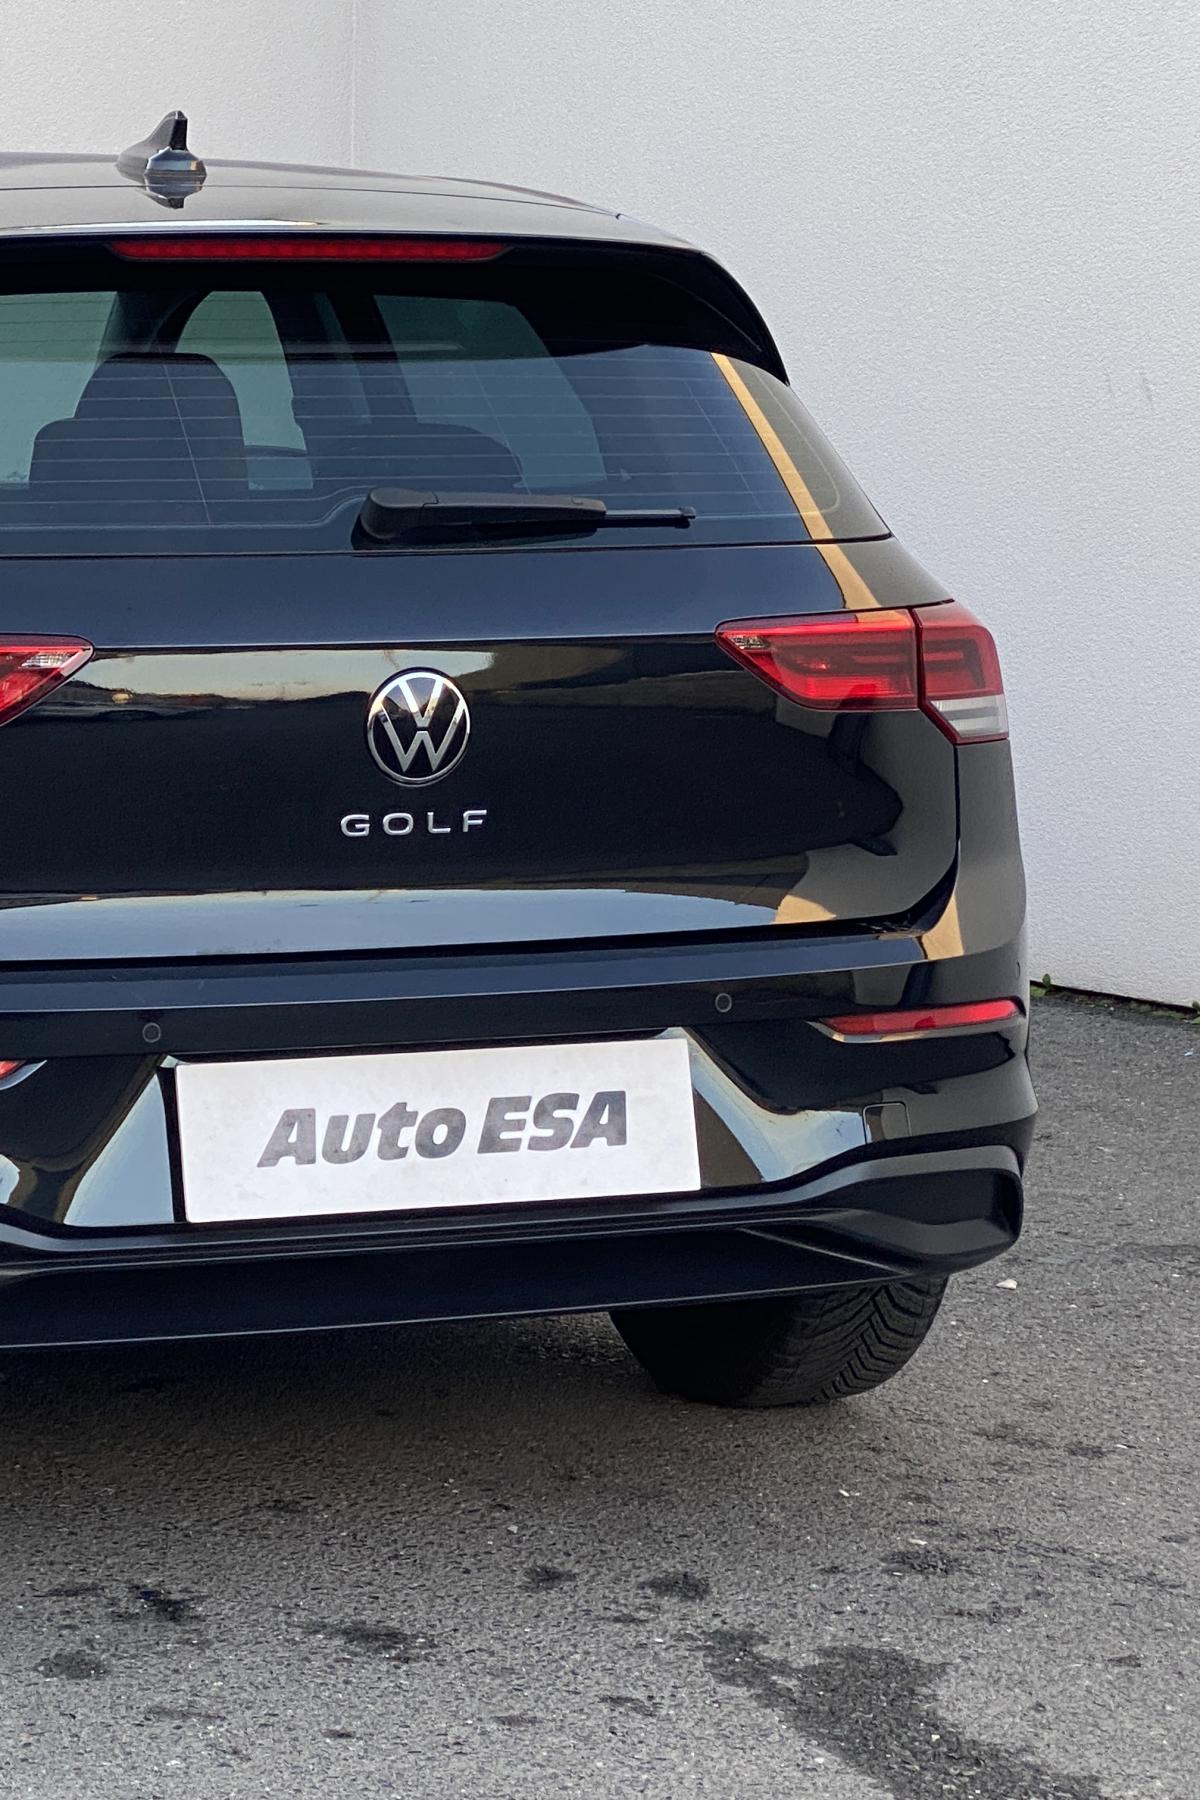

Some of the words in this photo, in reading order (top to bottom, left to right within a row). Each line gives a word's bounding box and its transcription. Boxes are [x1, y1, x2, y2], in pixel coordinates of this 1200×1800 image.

[373, 674, 468, 774] VW
[340, 809, 487, 837] GOLF
[256, 1101, 467, 1168] Auto
[477, 1091, 628, 1155] ESA
